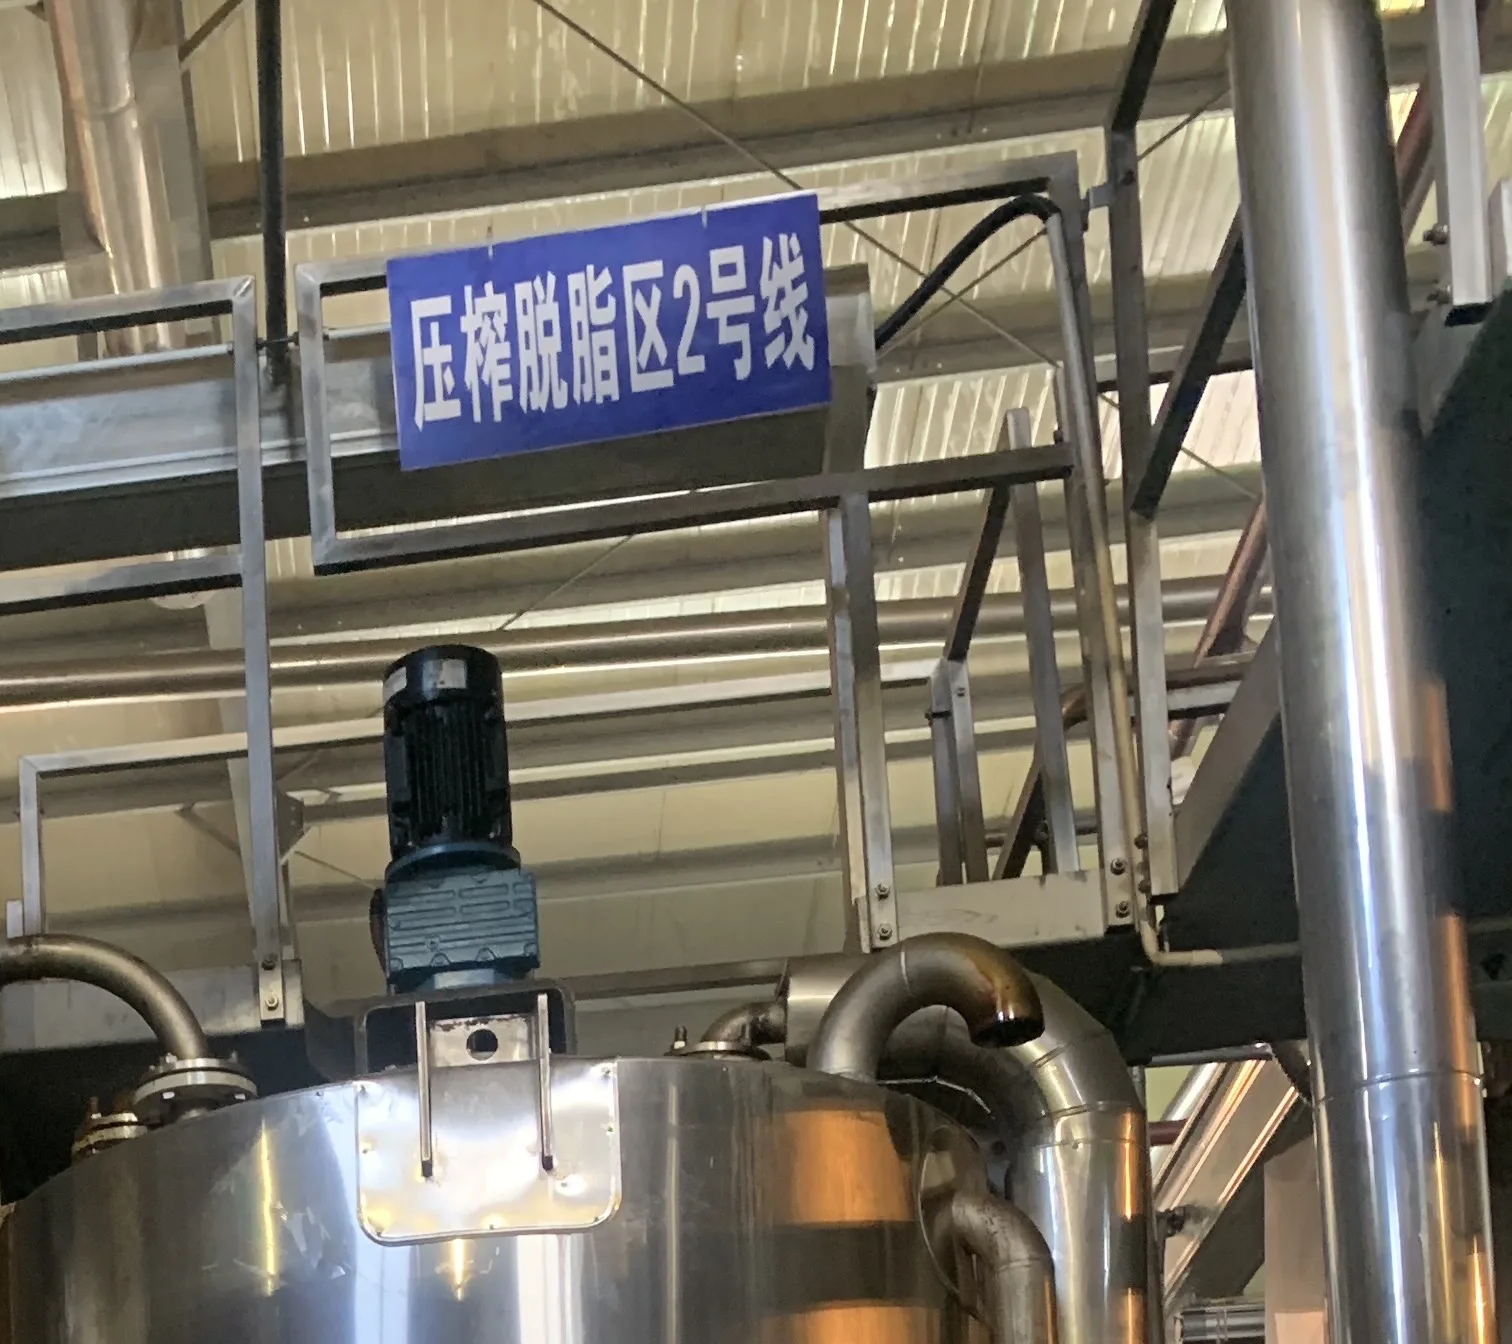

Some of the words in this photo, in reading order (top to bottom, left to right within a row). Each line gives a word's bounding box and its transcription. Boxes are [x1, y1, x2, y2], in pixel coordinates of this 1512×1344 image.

[410, 231, 816, 431] 压榨脱脂区2号线
